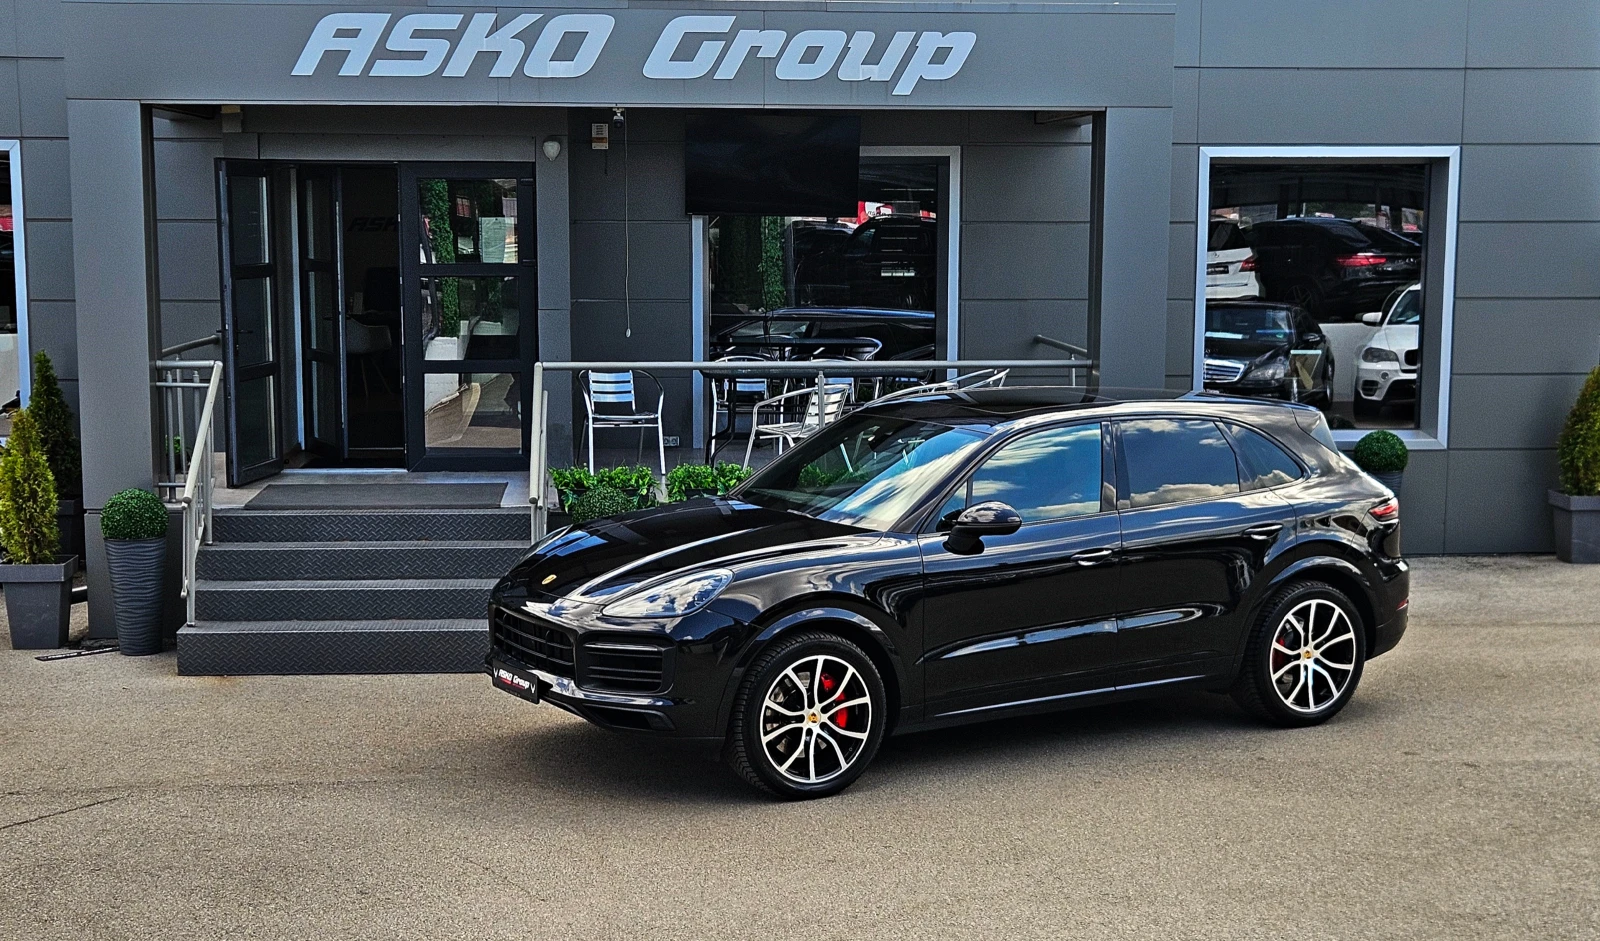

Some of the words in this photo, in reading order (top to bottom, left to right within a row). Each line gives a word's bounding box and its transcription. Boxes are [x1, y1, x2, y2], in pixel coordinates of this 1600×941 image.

[291, 13, 615, 78] ASKO
[642, 15, 977, 96] Group
[512, 675, 530, 690] Group
